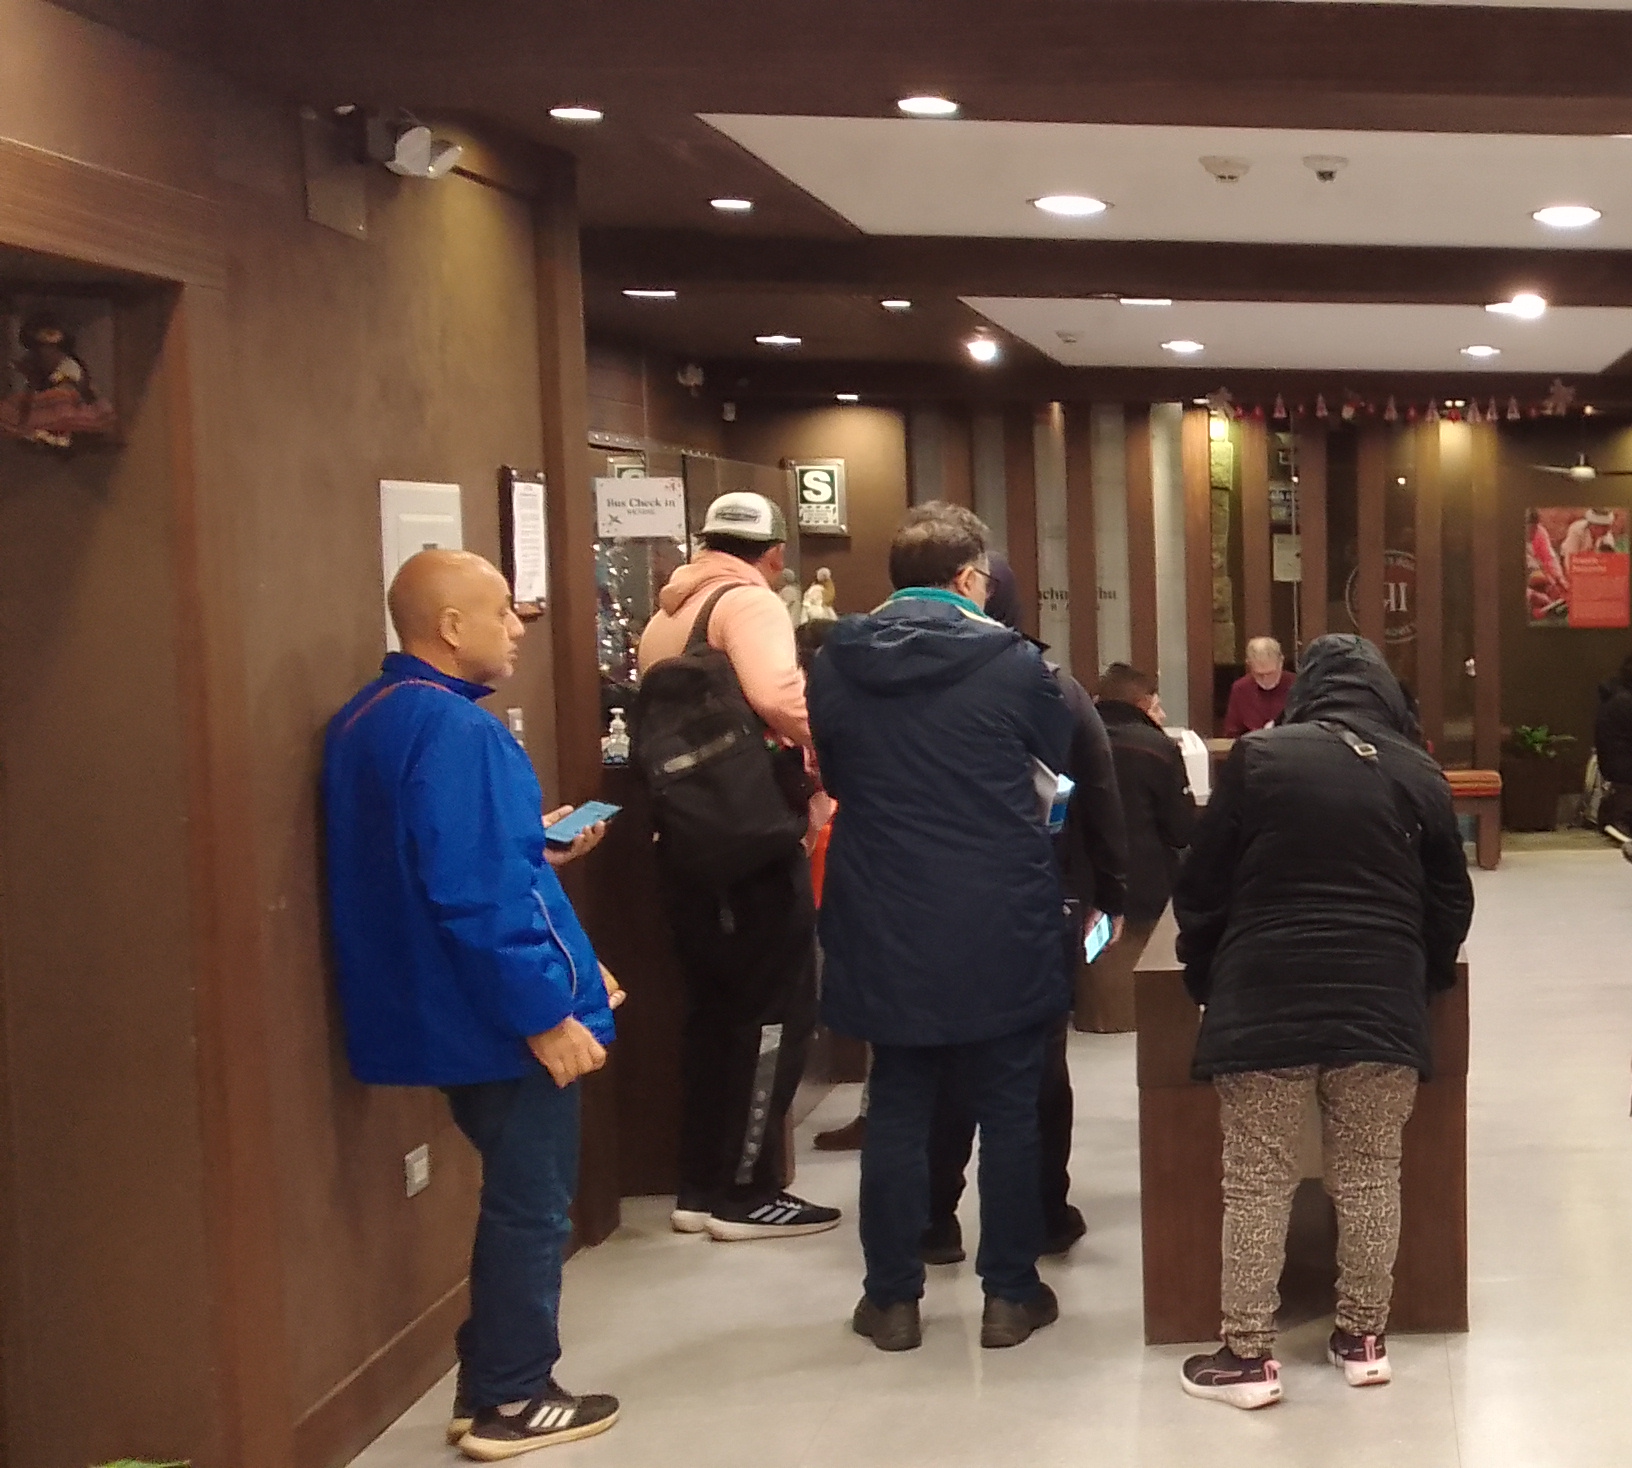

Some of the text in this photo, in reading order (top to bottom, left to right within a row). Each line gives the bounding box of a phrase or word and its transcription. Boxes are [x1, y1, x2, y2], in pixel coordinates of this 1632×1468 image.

[803, 470, 832, 503] S
[606, 498, 626, 507] Bus
[629, 497, 662, 508] Check
